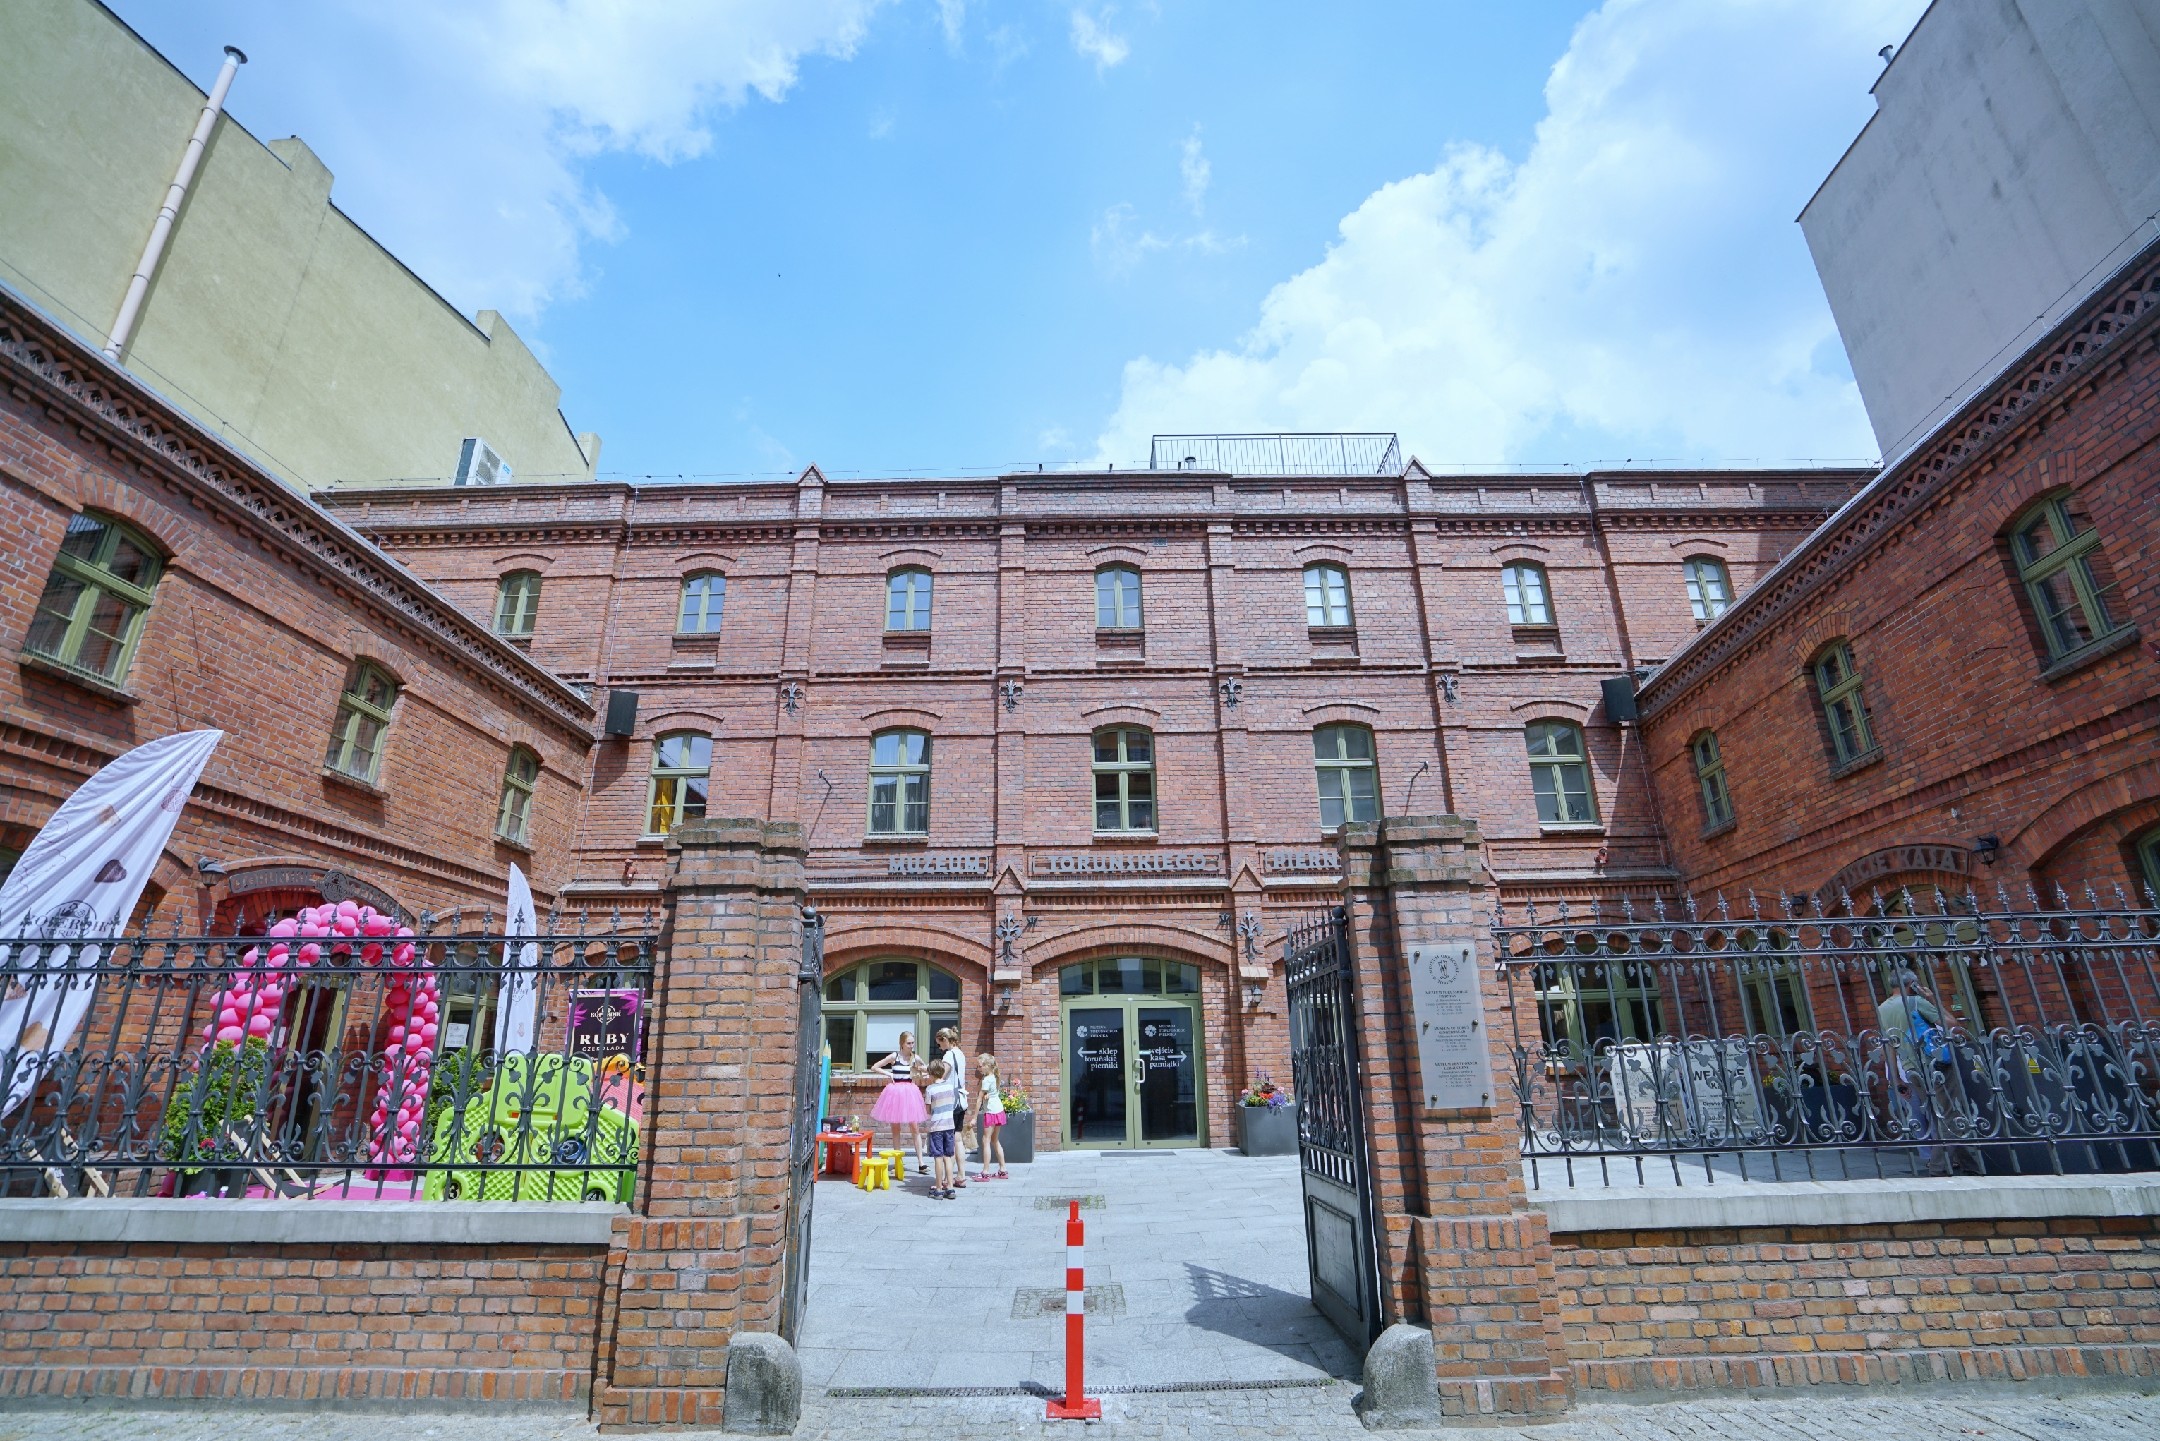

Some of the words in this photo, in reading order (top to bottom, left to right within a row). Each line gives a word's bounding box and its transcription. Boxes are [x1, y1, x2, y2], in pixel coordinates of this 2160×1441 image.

[579, 1033, 629, 1045] RUBY
[1098, 1047, 1118, 1056] sklep
[1150, 1053, 1166, 1061] kasa
[1090, 1062, 1119, 1072] pierniki
